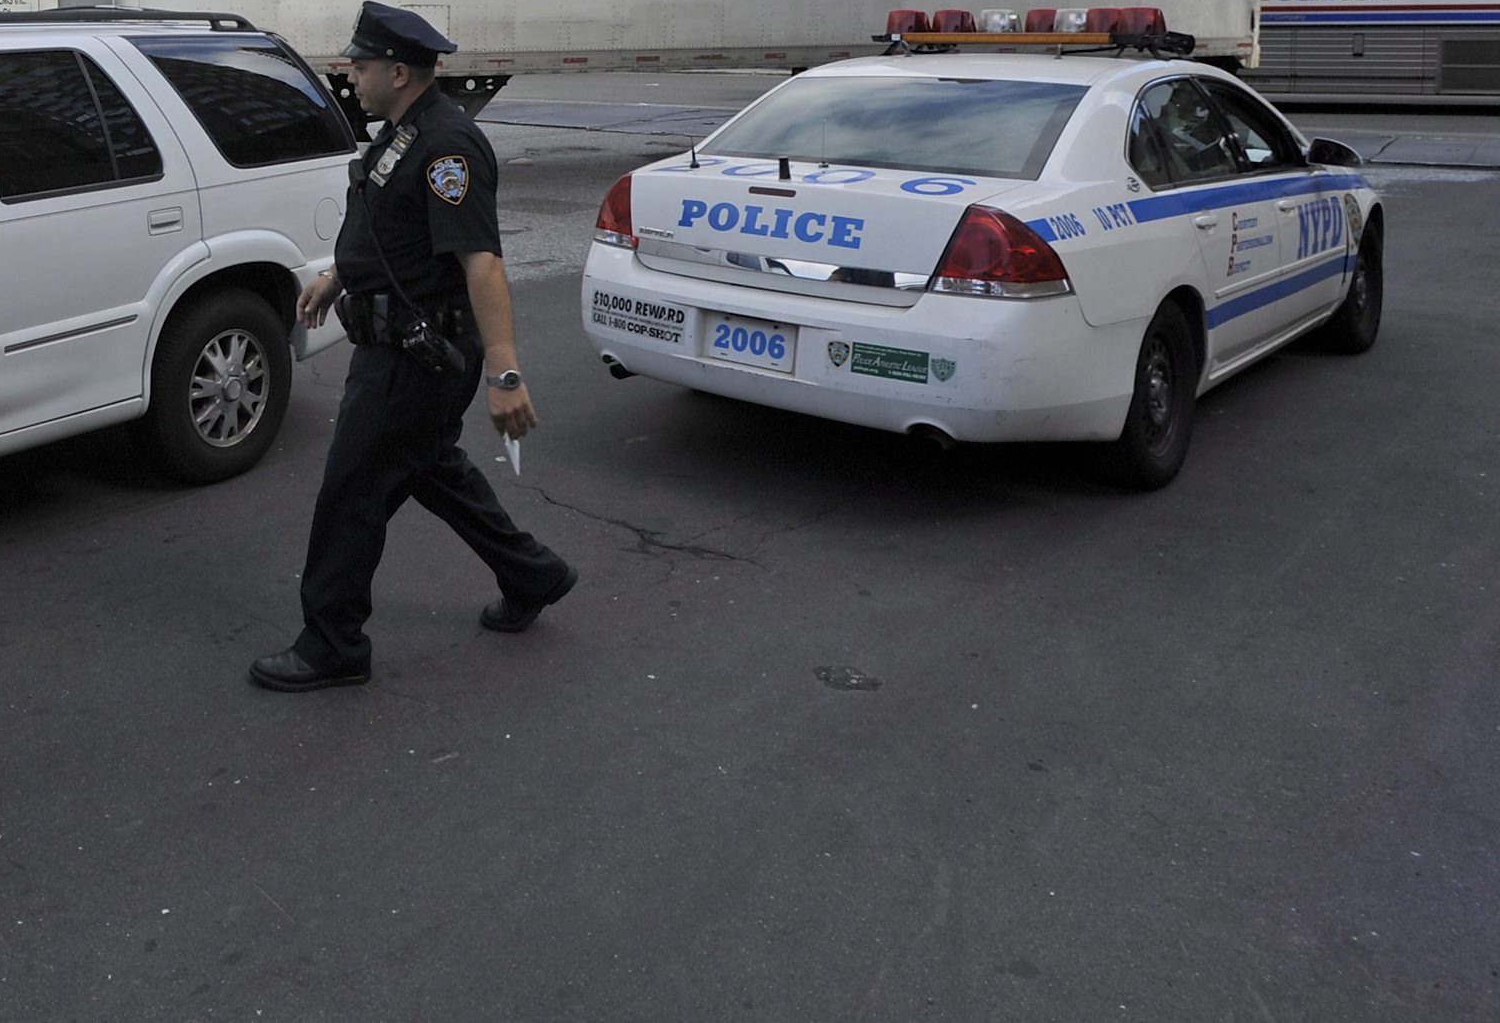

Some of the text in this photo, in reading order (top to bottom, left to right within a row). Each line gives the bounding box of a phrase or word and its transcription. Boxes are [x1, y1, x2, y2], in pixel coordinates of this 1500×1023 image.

[678, 198, 865, 250] POLICE
[1049, 203, 1134, 240] 2006 10 PCT
[1297, 196, 1343, 260] NYPD
[593, 312, 607, 326] CALL
[609, 316, 627, 330] 1-800
[594, 290, 633, 313] $10,000
[634, 301, 685, 324] REWARD
[713, 323, 786, 360] 2006
